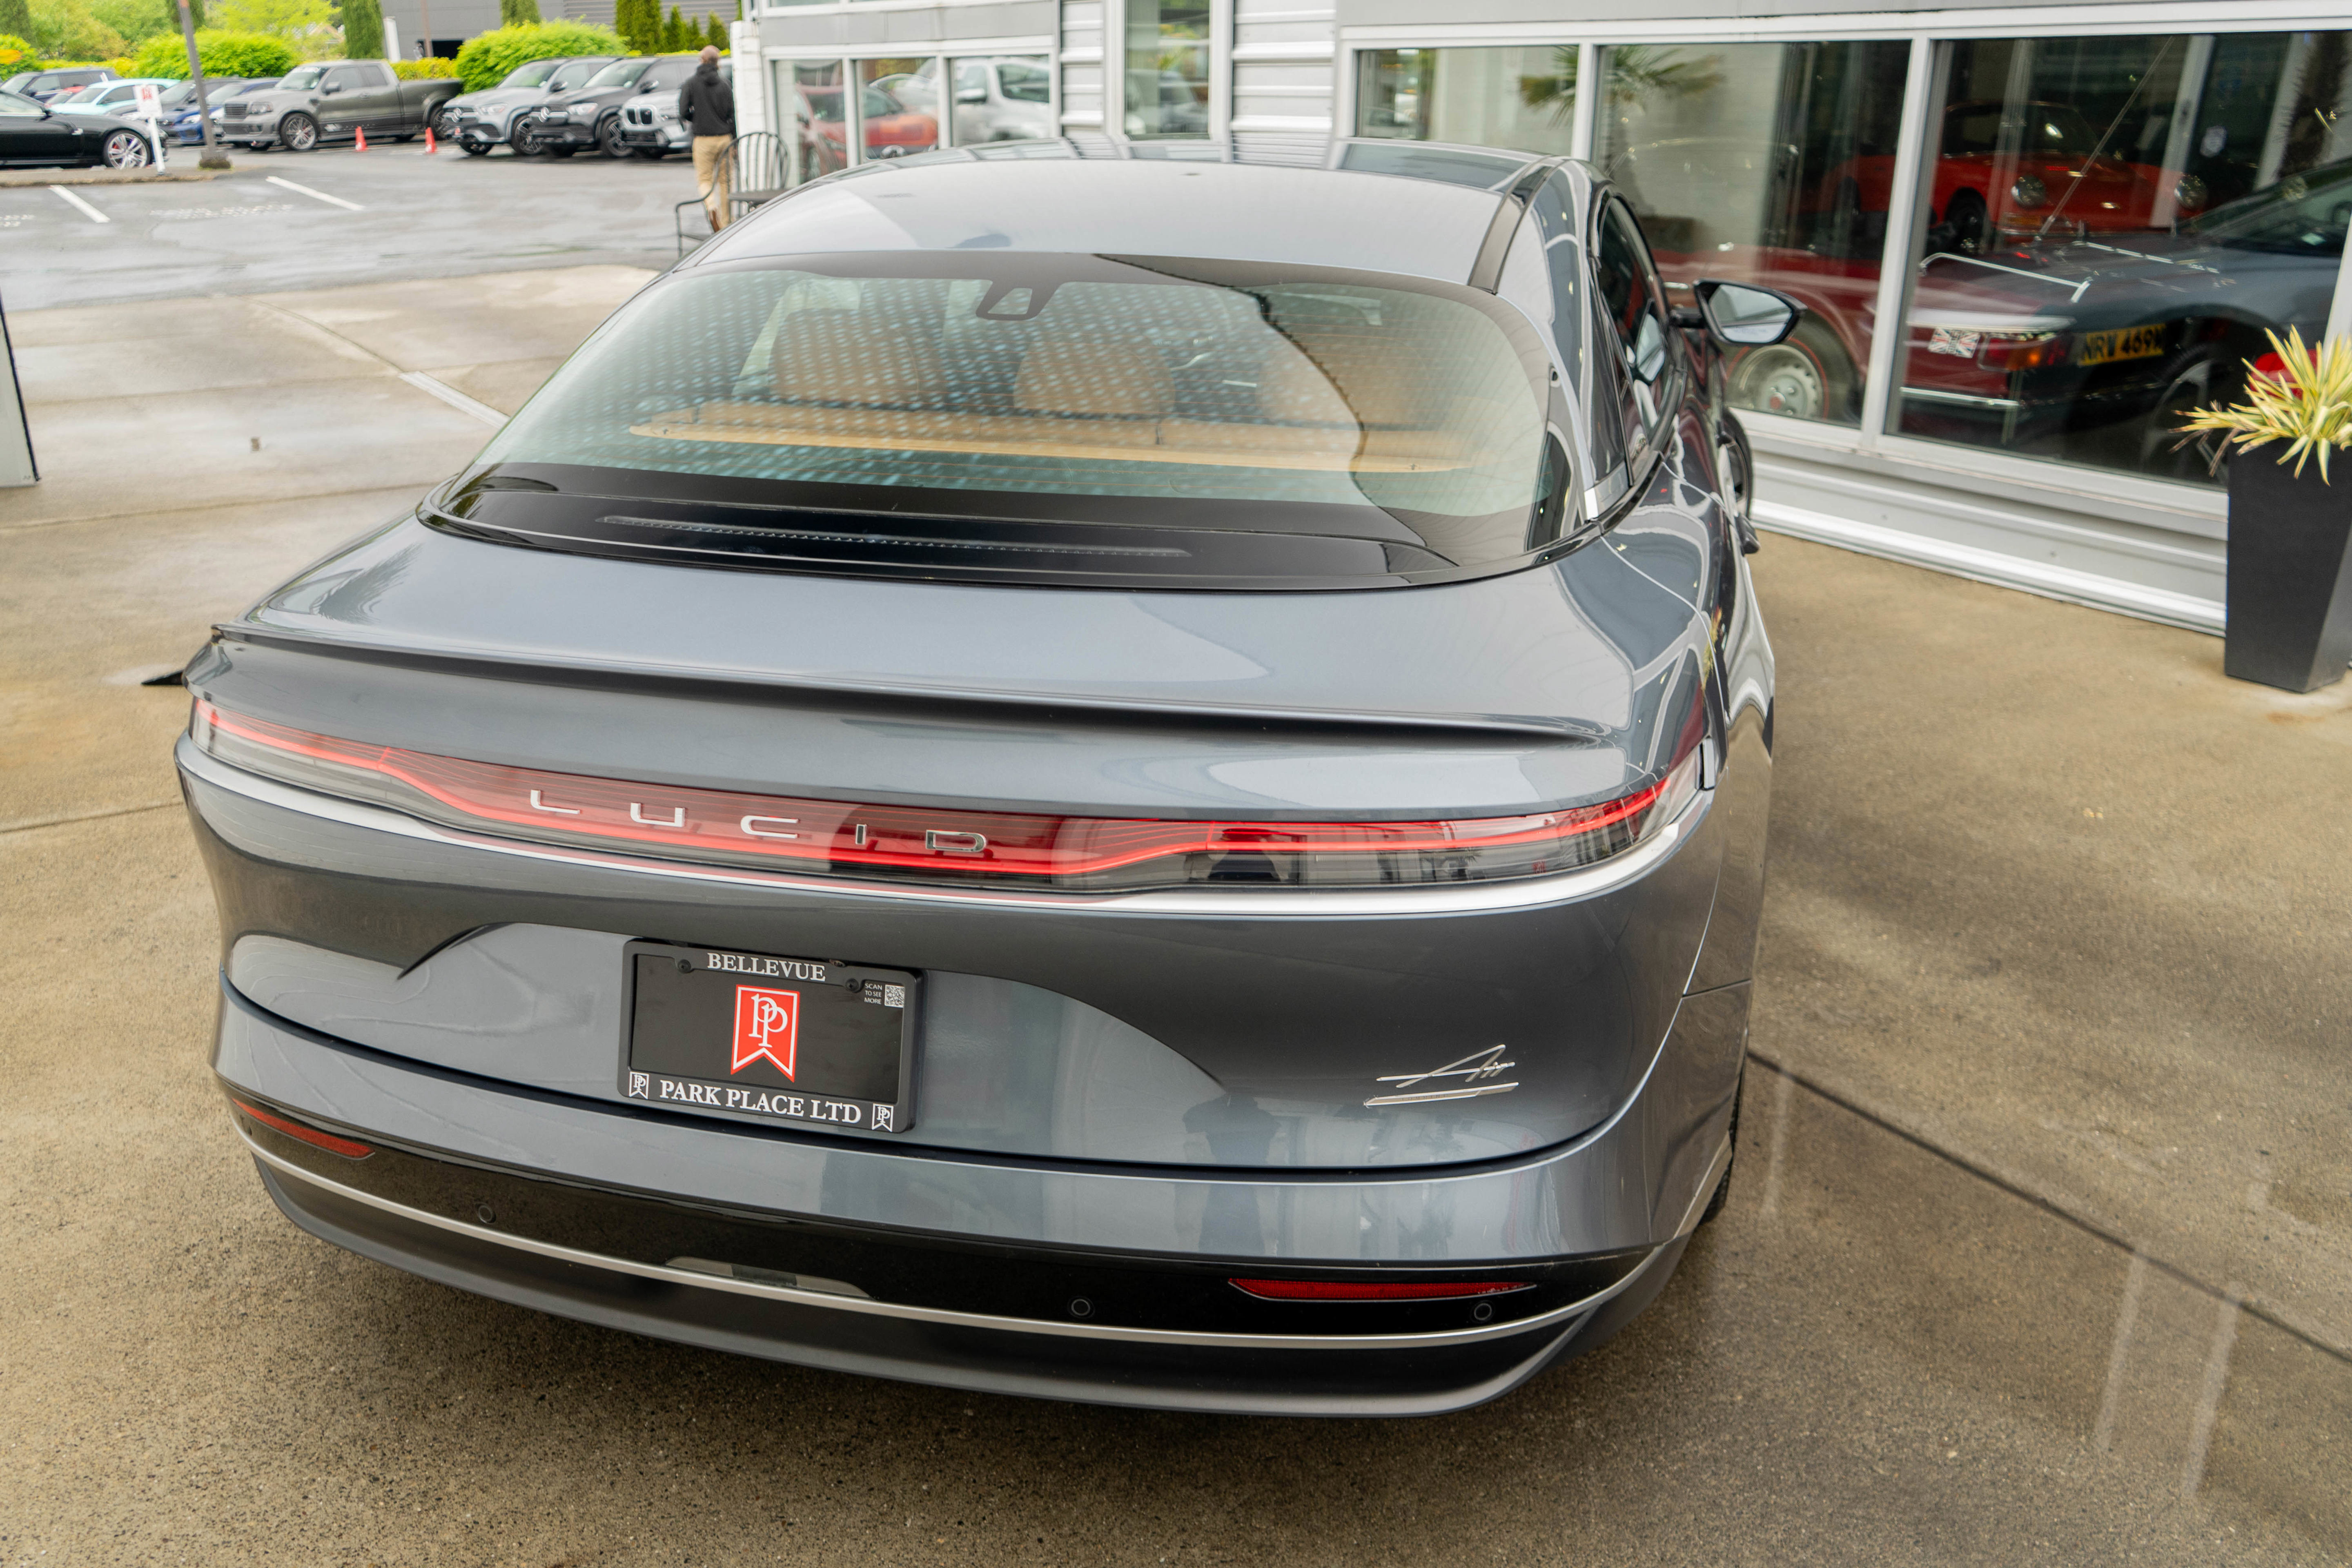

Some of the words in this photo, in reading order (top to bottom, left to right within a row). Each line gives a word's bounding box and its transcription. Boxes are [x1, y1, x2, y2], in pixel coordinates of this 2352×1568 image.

[530, 789, 987, 853] LUCID
[707, 952, 826, 982] BELLEVUE
[864, 982, 882, 991] SCAN
[659, 1079, 722, 1107] PARK
[725, 1088, 805, 1117] PLACE
[809, 1100, 862, 1125] LTD
